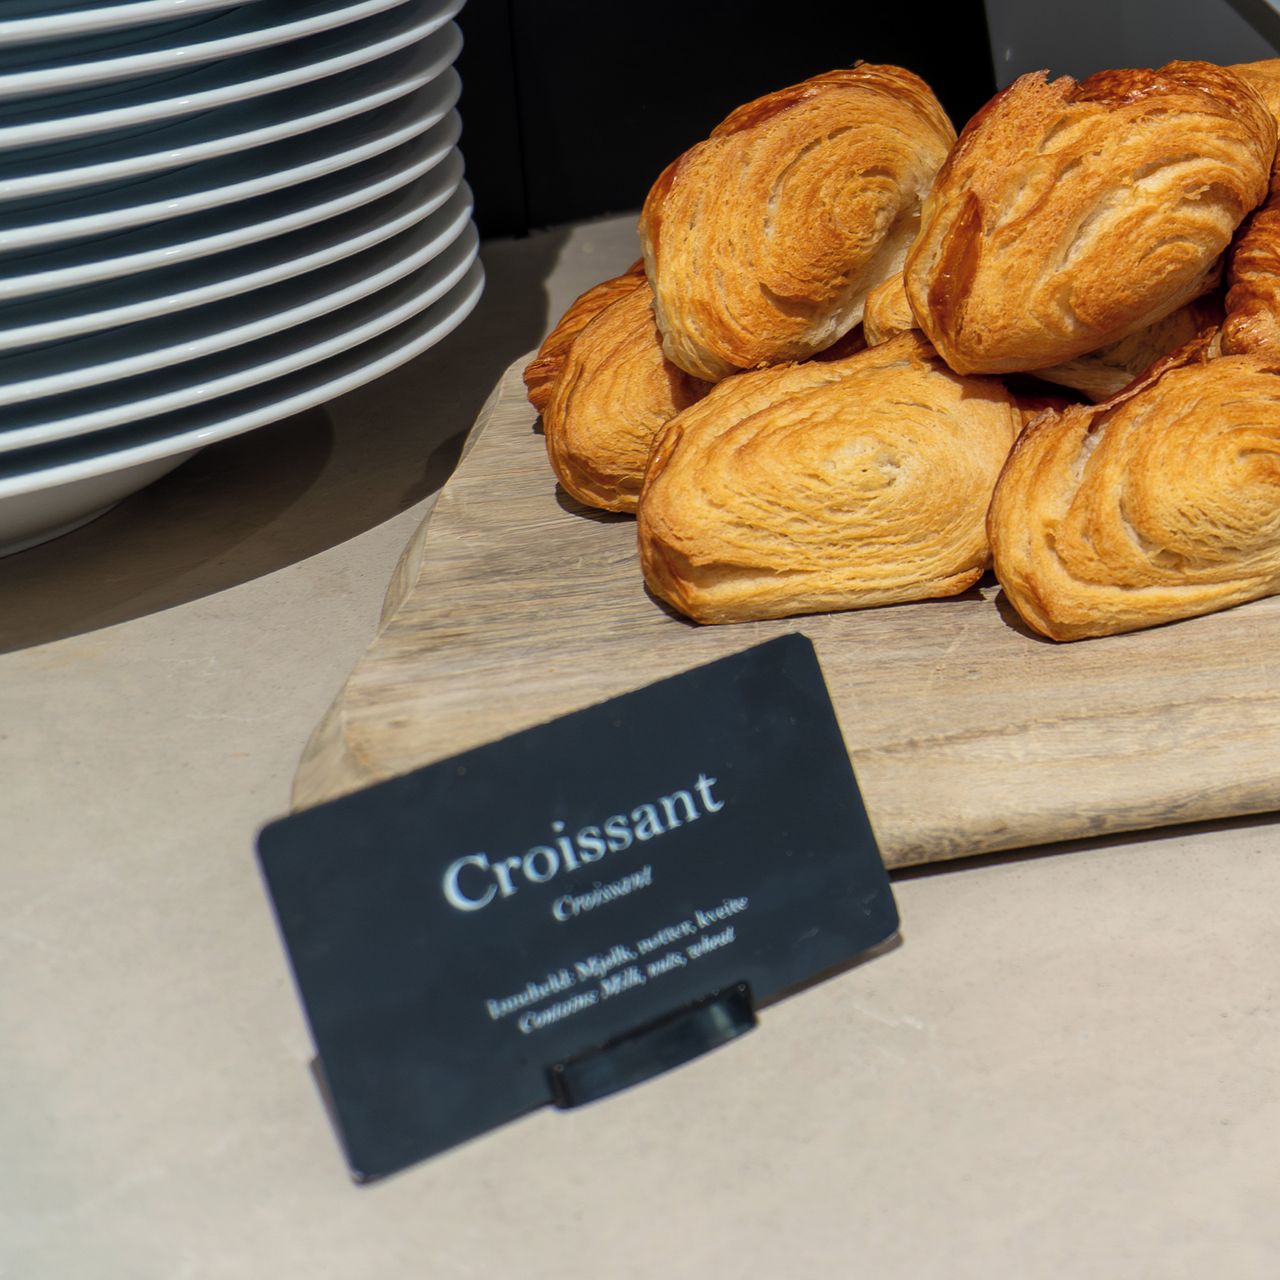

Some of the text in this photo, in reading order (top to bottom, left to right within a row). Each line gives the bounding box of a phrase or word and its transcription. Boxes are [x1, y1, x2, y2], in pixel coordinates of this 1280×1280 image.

[442, 773, 725, 912] Croissant
[552, 864, 654, 922] Croissant
[695, 895, 749, 929] kveite
[687, 925, 736, 959] wheat
